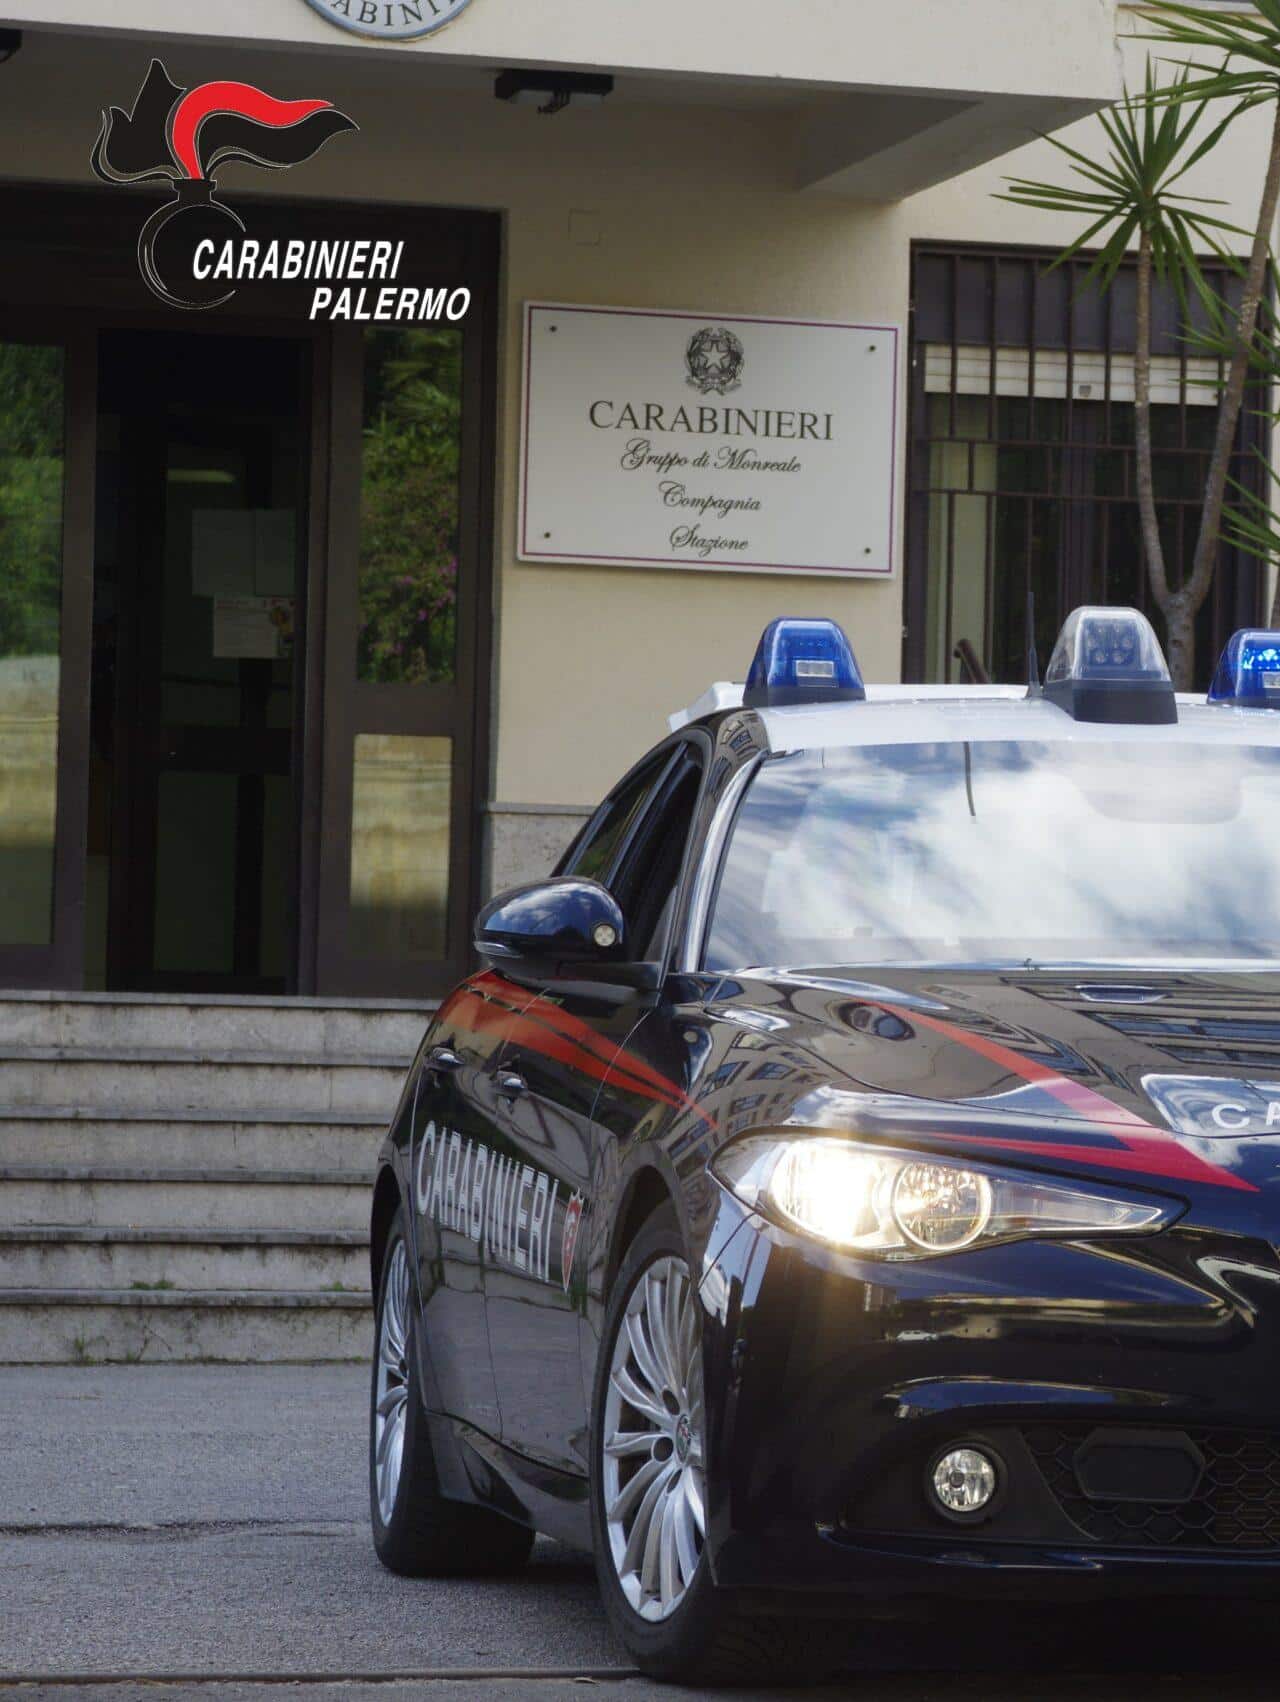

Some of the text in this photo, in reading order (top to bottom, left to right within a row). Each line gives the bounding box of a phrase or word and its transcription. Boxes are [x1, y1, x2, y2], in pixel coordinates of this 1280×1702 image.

[588, 400, 834, 440] CARABINIERI
[620, 438, 801, 472] Gruppo di Monreale
[658, 480, 761, 519] Compagnia
[669, 524, 748, 556] Stazione
[417, 1120, 560, 1283] CARABINIERI
